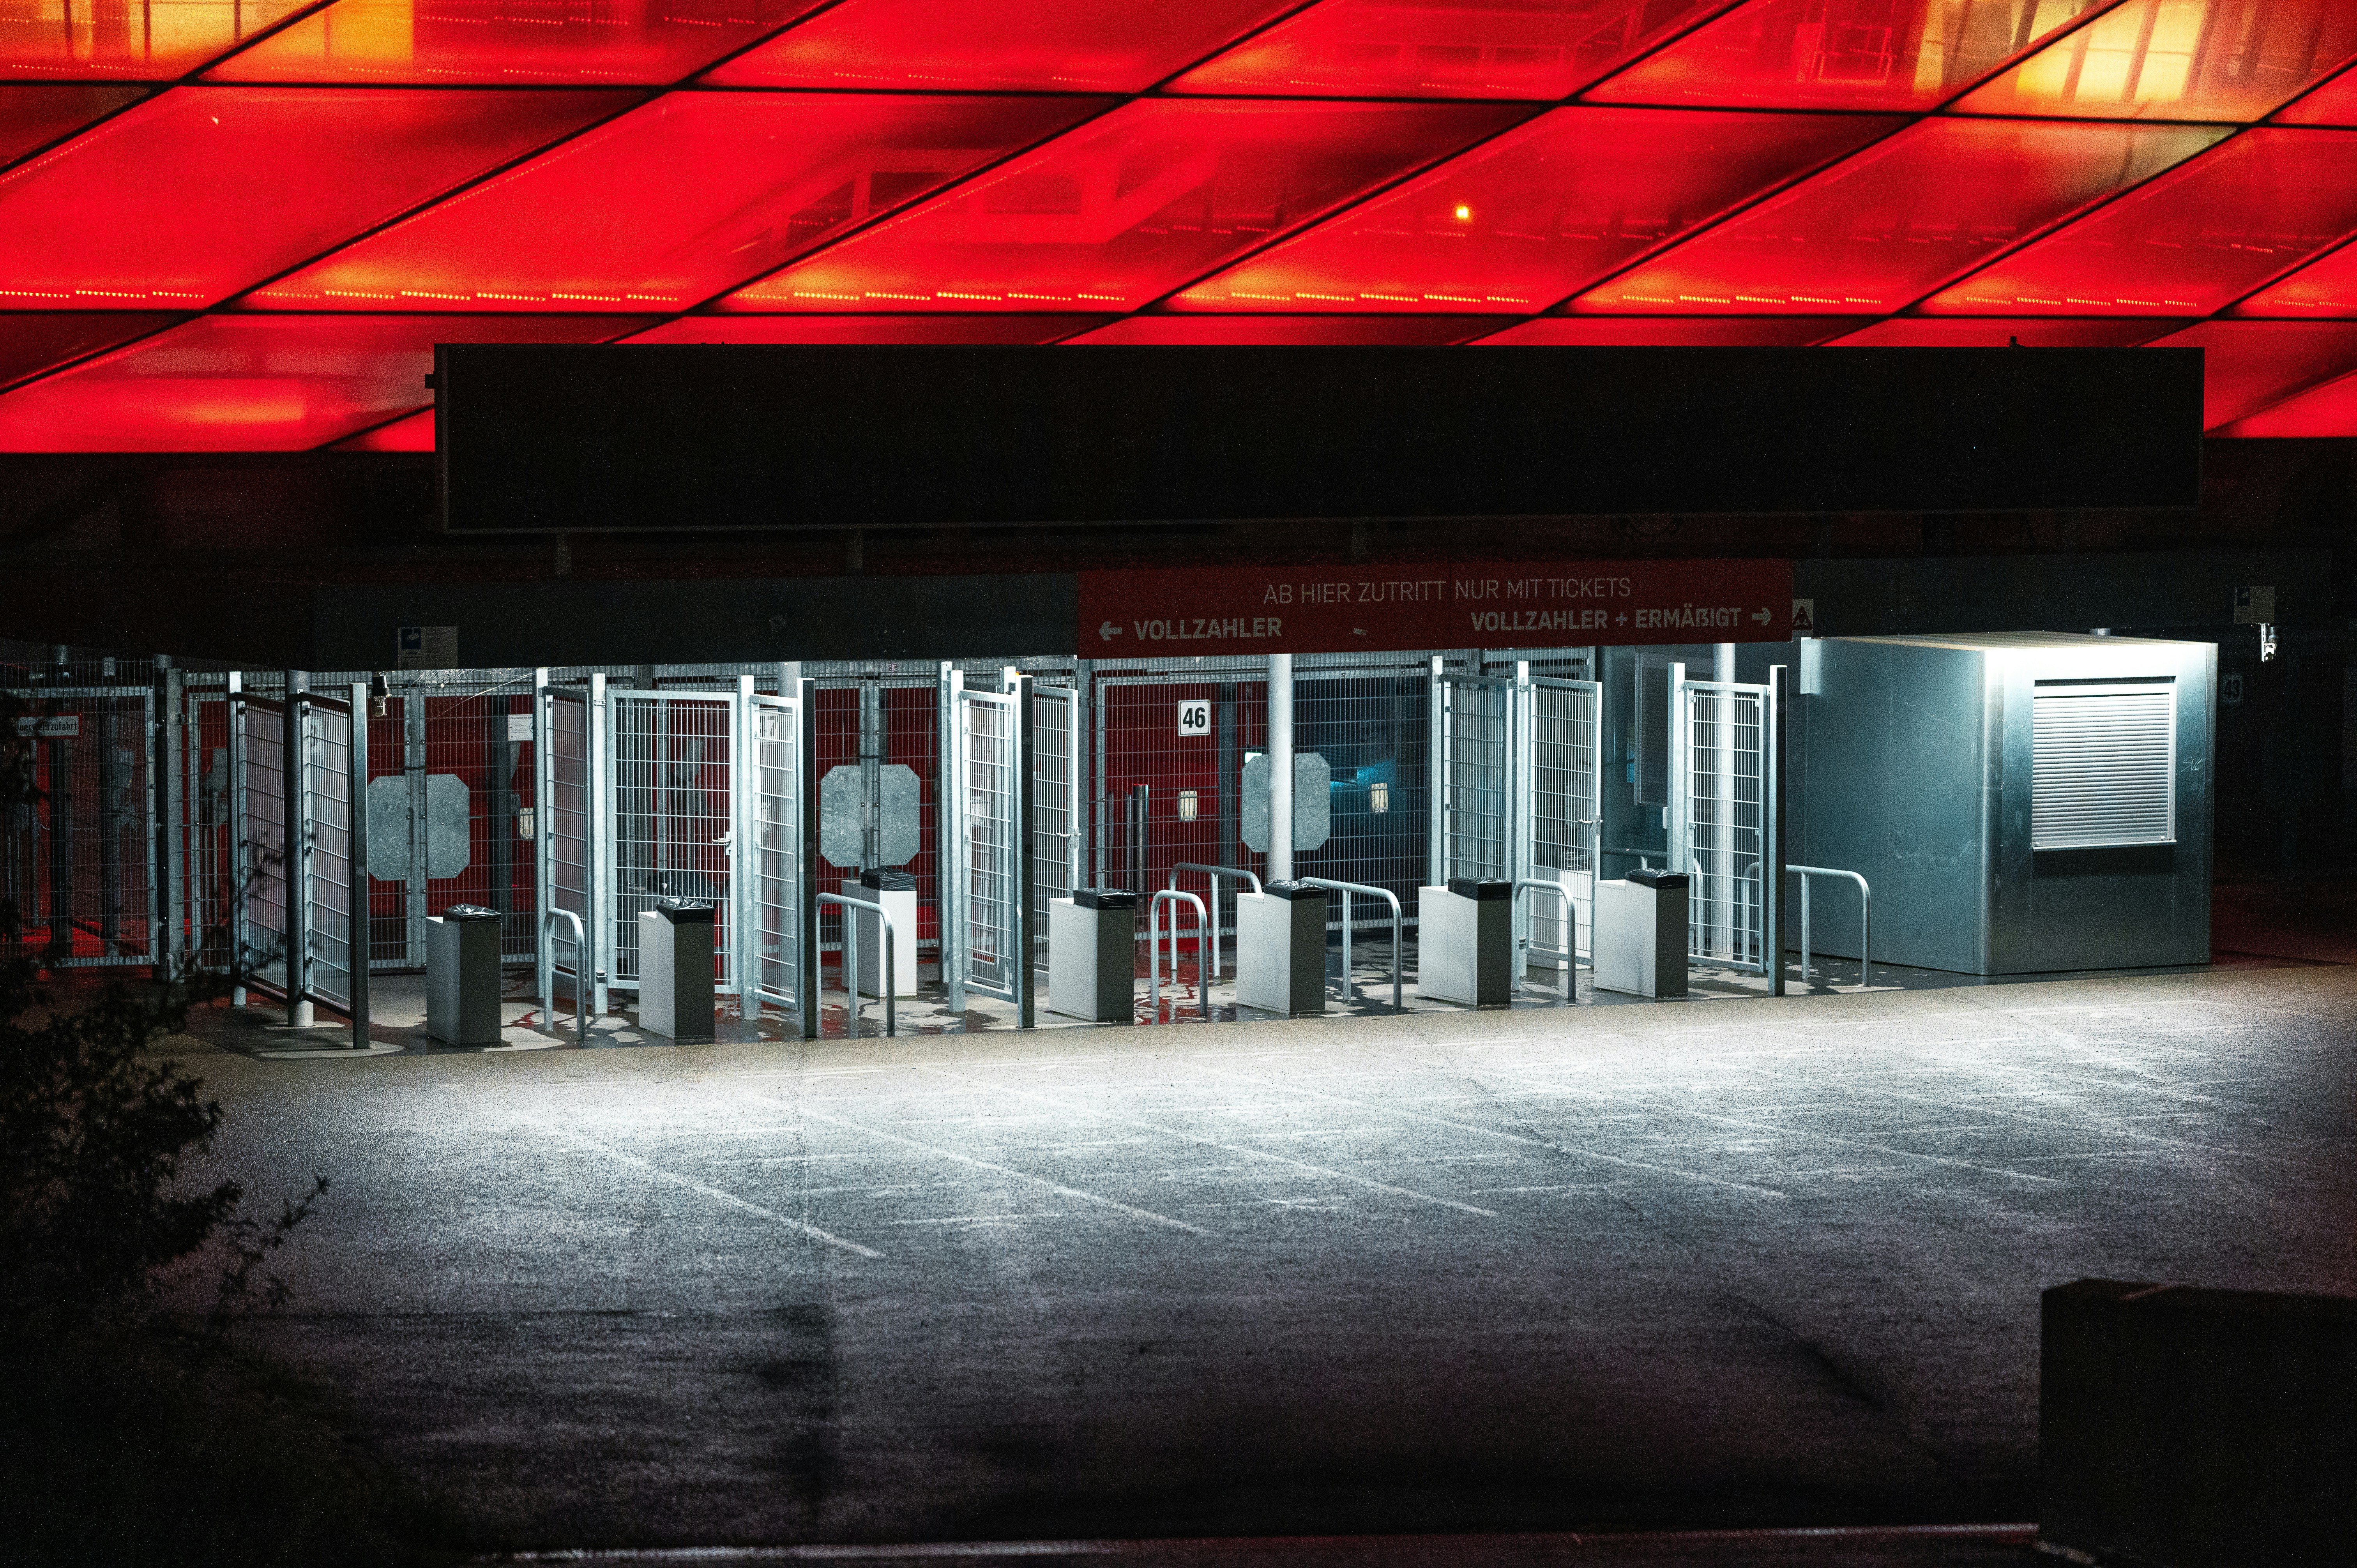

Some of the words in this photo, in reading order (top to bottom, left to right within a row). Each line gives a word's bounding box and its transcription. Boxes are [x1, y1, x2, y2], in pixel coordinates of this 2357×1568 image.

[1263, 584, 1292, 604] AB
[1301, 583, 1350, 603] HIER
[1358, 581, 1446, 602] ZUTRITT
[1456, 579, 1498, 599] NUR
[1507, 579, 1542, 599] MIT
[1547, 577, 1631, 598] TICKETS
[1134, 617, 1282, 640] VOLLZAHLER
[1471, 610, 1608, 631] VOLLZAHLER
[1615, 612, 1628, 626] +
[2224, 679, 2240, 698] 43
[1182, 707, 1205, 728] 46
